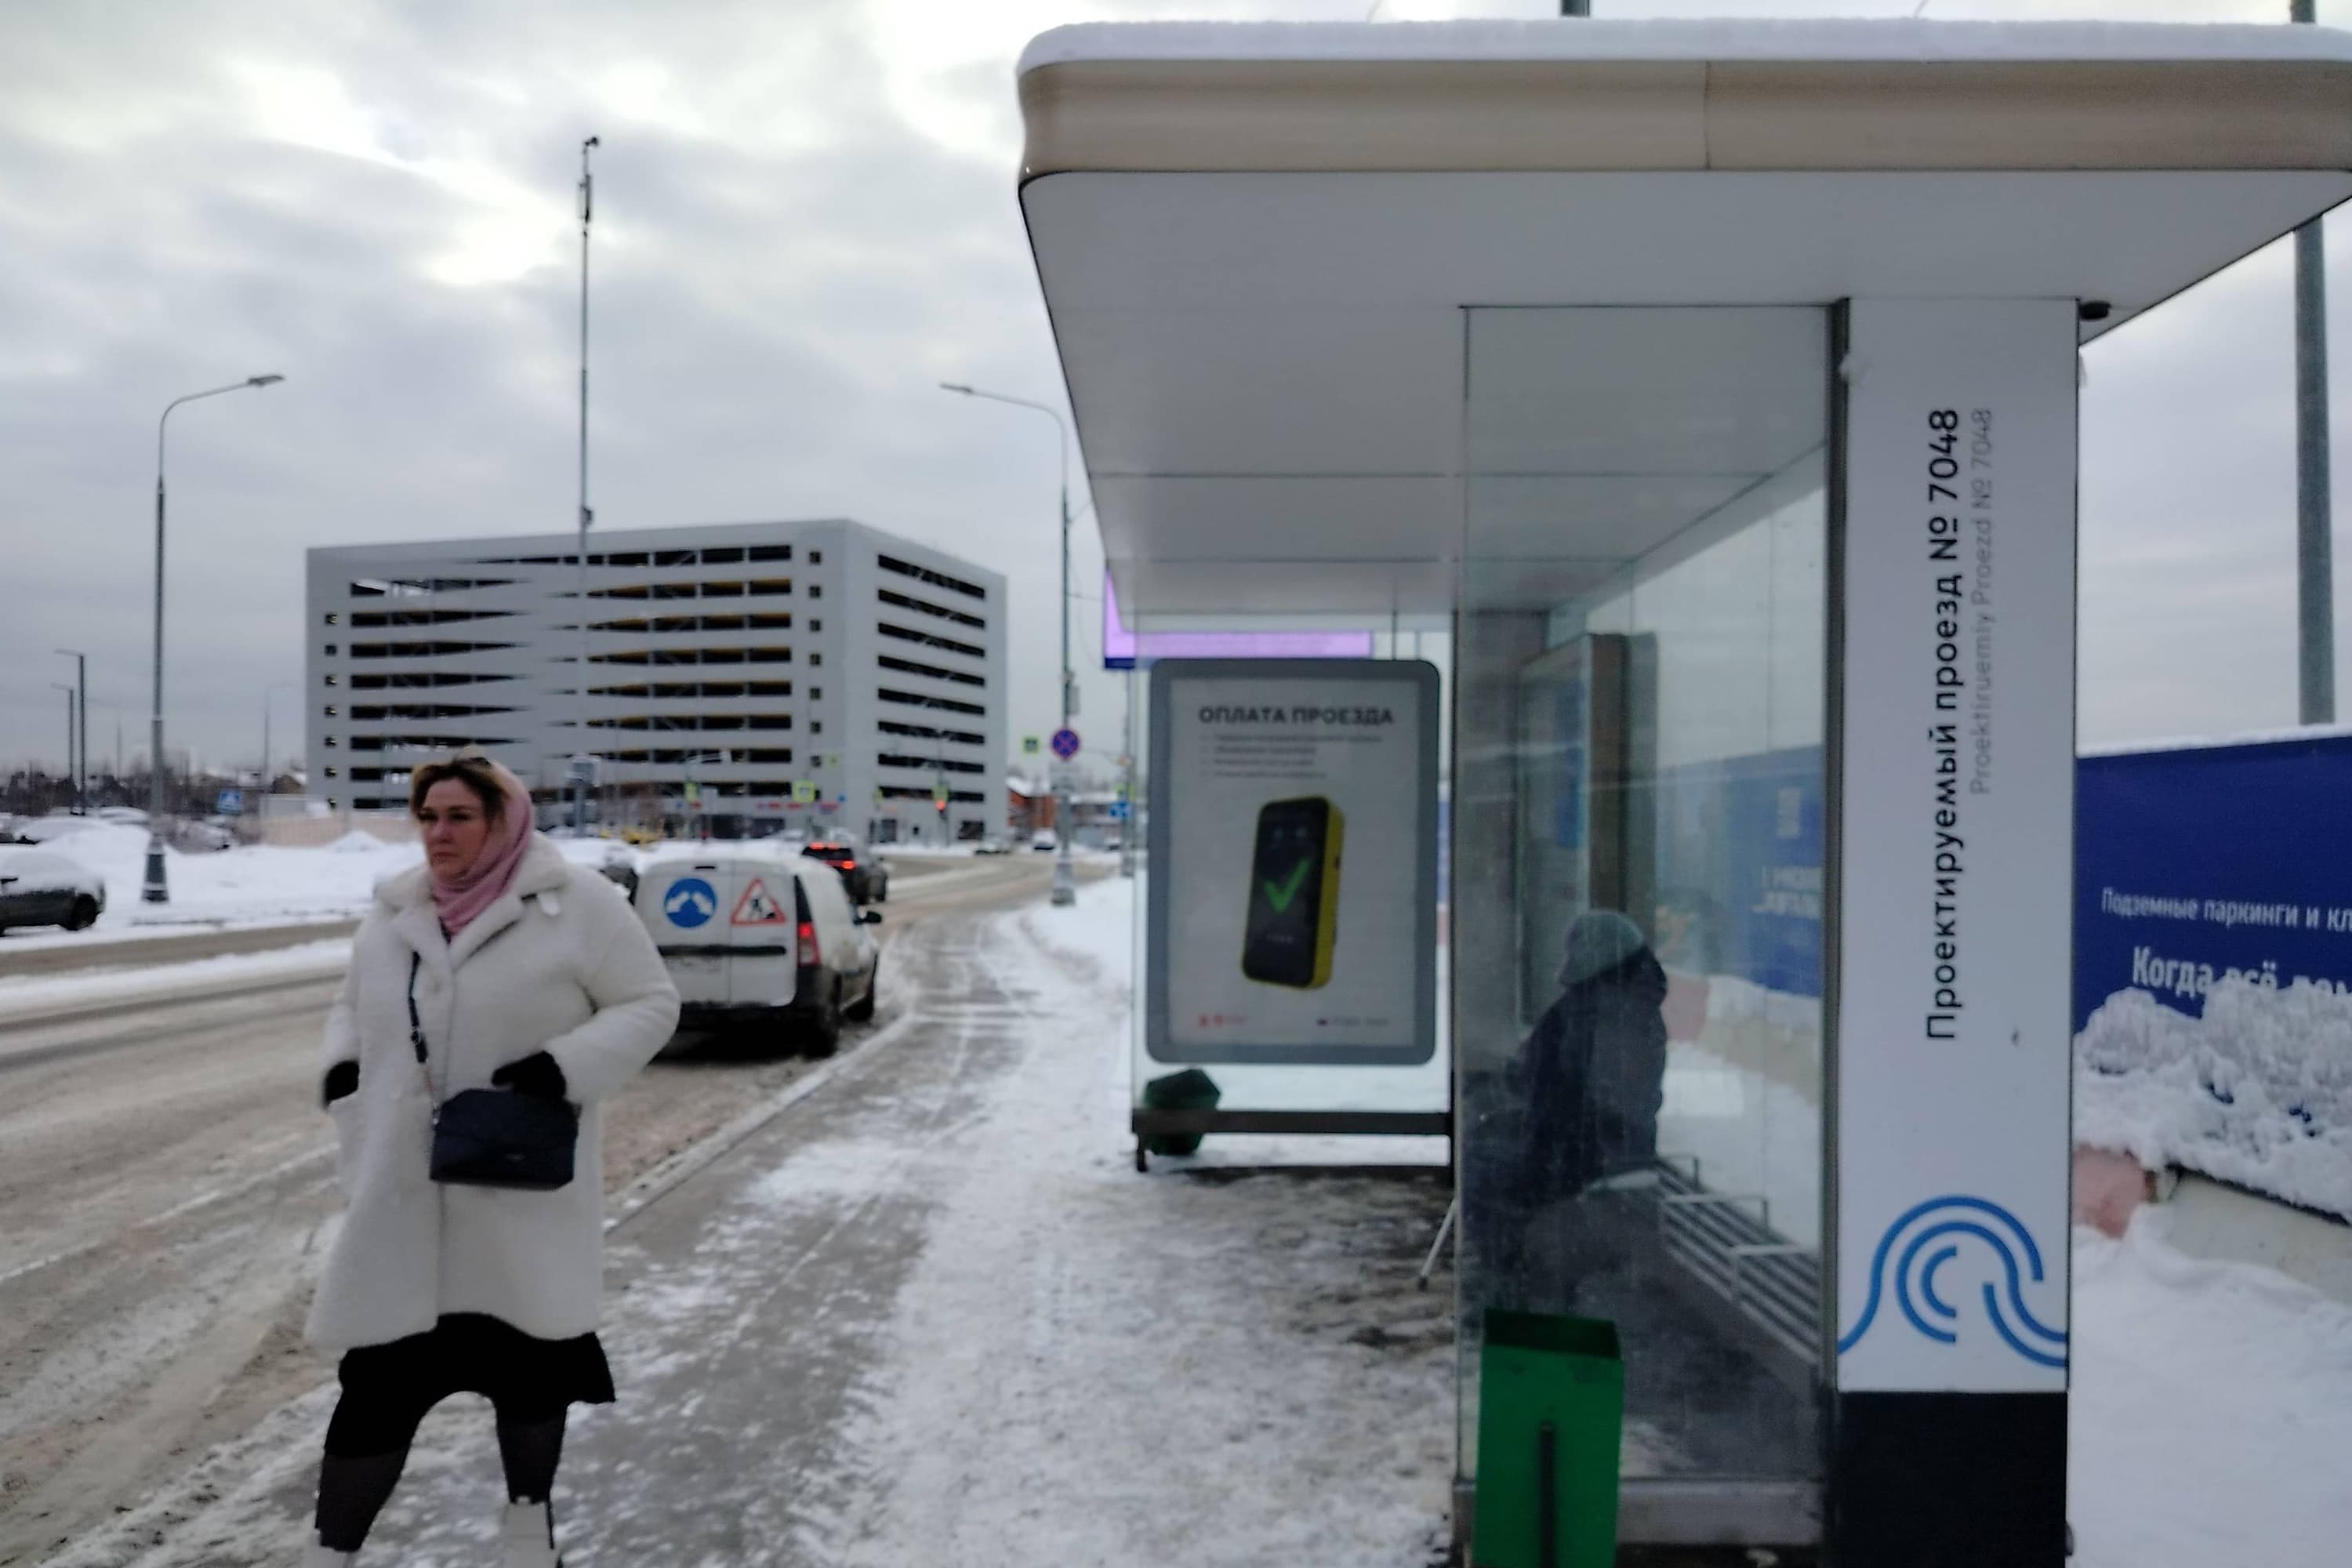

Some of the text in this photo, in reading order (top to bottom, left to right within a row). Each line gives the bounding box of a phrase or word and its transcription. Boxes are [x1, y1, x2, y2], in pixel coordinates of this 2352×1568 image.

[1970, 407, 1992, 469] 7048
[1970, 517, 1992, 606] Proezd
[1198, 706, 1394, 725] ОПЛАТА ПРОЕЗДА
[1926, 409, 1964, 1038] Проектируемый проезд № 7048
[1969, 612, 1996, 793] Proektiruemiy
[2101, 887, 2198, 920] Подземные
[2203, 899, 2299, 929] паркинги
[2306, 906, 2320, 929] и
[2132, 946, 2214, 1000] Когда
